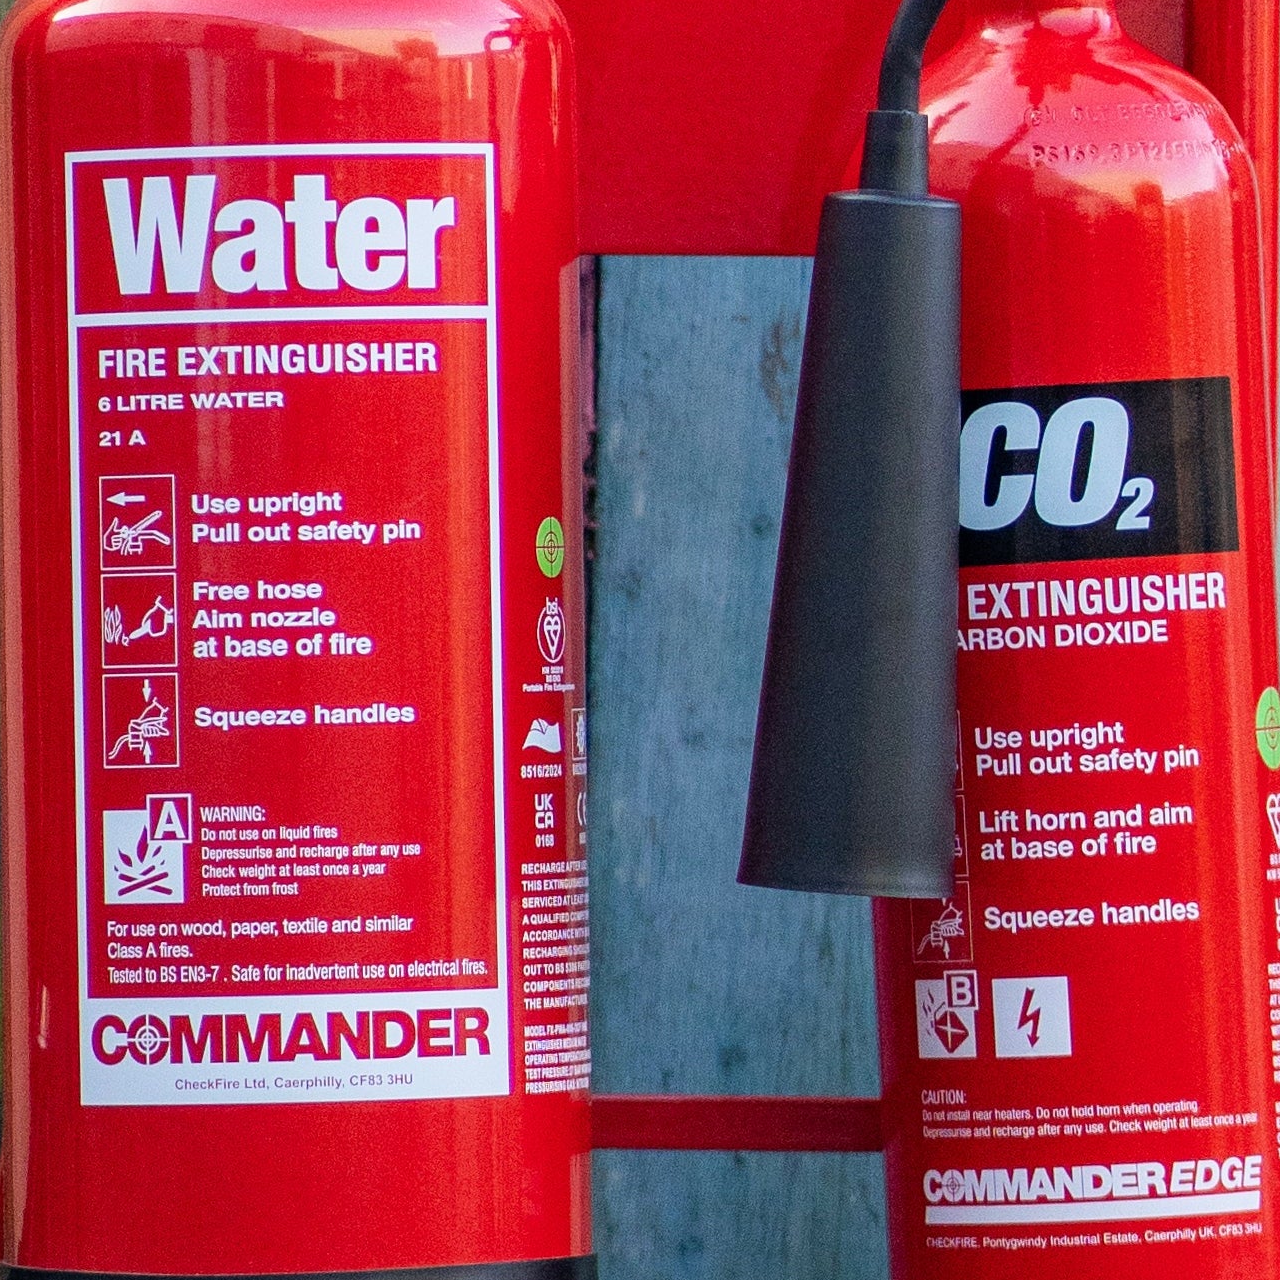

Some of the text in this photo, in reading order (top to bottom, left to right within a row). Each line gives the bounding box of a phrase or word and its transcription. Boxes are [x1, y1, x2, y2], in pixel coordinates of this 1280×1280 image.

[102, 174, 456, 295] Water
[99, 342, 438, 378] FIRE EXTINGUISHER
[98, 391, 284, 412] 6 LITRE WATER
[99, 430, 146, 447] 21 A
[192, 491, 343, 517] Use upright
[192, 519, 421, 544] Pull out safety pin
[193, 580, 323, 601] Free hose
[967, 572, 1226, 620] EXTINGUISHER
[192, 607, 336, 629] Aim nozzle
[193, 632, 373, 658] at base of fire
[957, 619, 1168, 650] ARBON DIOXIDE
[195, 703, 415, 731] Squeeze handles
[975, 721, 1124, 750] Use upright
[976, 744, 1199, 776] Pull out safety pin
[154, 800, 186, 840] A
[200, 805, 266, 822] WARNING:
[980, 801, 1193, 833] Lift horn and aim
[201, 825, 338, 841] Do not use on liquid fires
[201, 843, 421, 861] Depressurise and recharge after any use
[981, 832, 1157, 860] at base of fire
[201, 863, 386, 879] Check weight at least once a year
[202, 882, 299, 896] Protect from frost
[107, 915, 414, 938] For use on wood, paper, textile and similar
[984, 898, 1200, 934] Squeeze handles
[107, 941, 193, 959] Class A fires.
[108, 967, 142, 983] Tested
[145, 968, 157, 983] to
[160, 965, 177, 983] BS
[231, 964, 261, 982] Safe
[263, 964, 283, 981] for
[286, 963, 360, 980] inadvertent
[362, 964, 385, 979] use
[388, 964, 405, 978] on
[407, 959, 460, 977] electrical
[461, 959, 488, 975] fires.
[950, 977, 972, 1006] B
[91, 1007, 490, 1066] COMMANDER
[175, 1074, 413, 1090] CheckFire Ltd, Caerphilly, CF83 3HU
[921, 1089, 967, 1105] CAUTION:
[973, 1110, 992, 1121] near
[994, 1109, 1033, 1120] heaters.
[1036, 1107, 1050, 1119] Do
[1052, 1107, 1069, 1118] not
[1071, 1105, 1094, 1118] hold
[1096, 1105, 1121, 1116] horn
[1122, 1103, 1152, 1116] when
[1152, 1100, 1199, 1115] operating
[974, 1126, 990, 1137] and
[993, 1125, 1035, 1138] recharge
[1037, 1123, 1061, 1136] after
[1064, 1124, 1083, 1136] any
[1085, 1123, 1106, 1134] use.
[1109, 1119, 1142, 1133] Check
[1143, 1117, 1178, 1132] weight
[1179, 1117, 1189, 1129] at
[1191, 1115, 1212, 1128] least
[1214, 1116, 1234, 1126] once
[924, 1155, 1262, 1202] COMMANDER EDGE
[983, 1235, 1047, 1249] Pontygwindy
[1050, 1233, 1100, 1247] Industrial
[1145, 1228, 1197, 1243] Caerphilly
[1219, 1223, 1243, 1236] CF83
